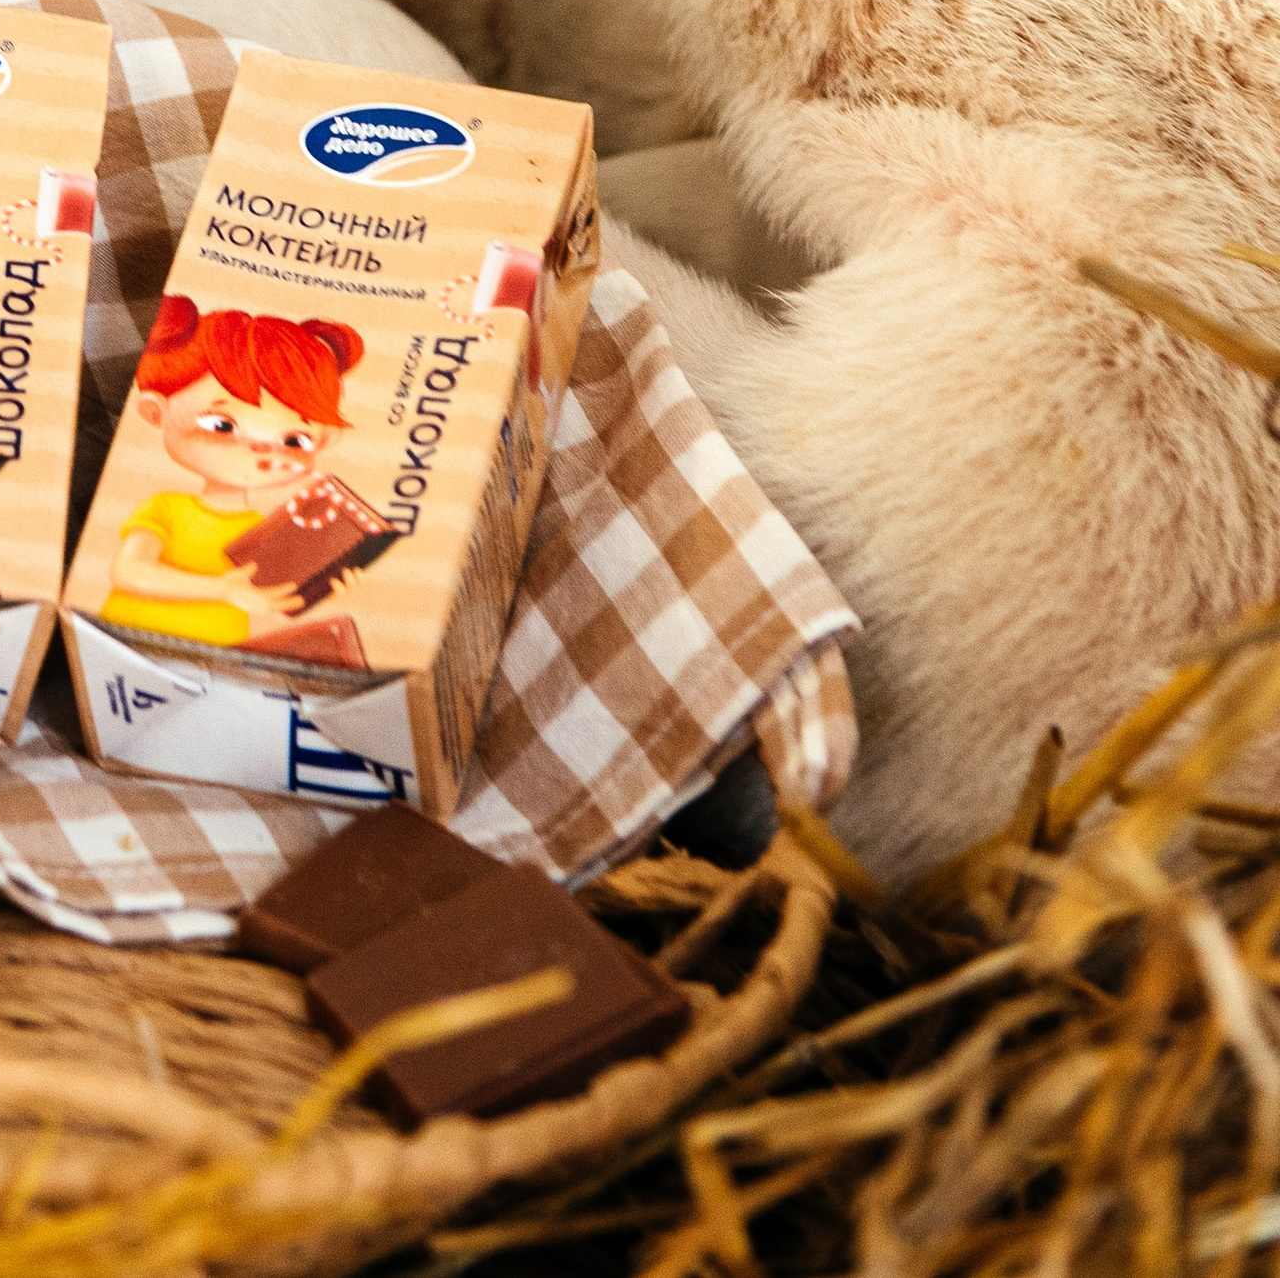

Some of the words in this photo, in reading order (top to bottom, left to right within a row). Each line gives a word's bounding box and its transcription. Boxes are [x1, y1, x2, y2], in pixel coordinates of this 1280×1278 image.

[324, 136, 385, 157] дело
[329, 116, 439, 144] Хорошее
[216, 185, 429, 243] МОЛОЧНЫЙ
[206, 216, 383, 274] КОКТЕЙЛЬ
